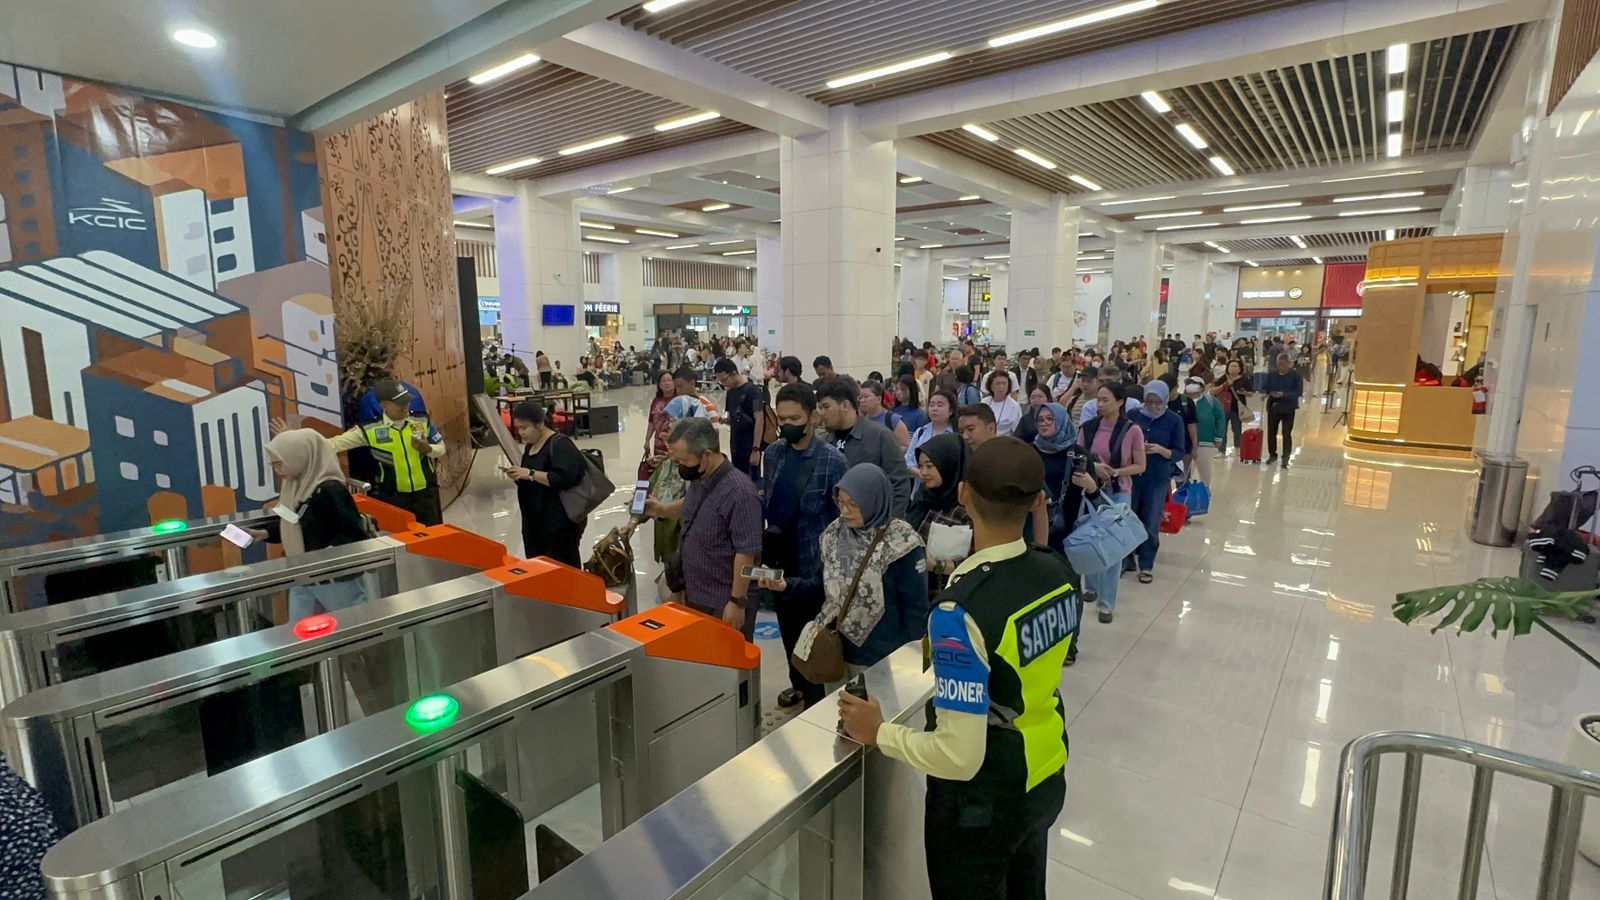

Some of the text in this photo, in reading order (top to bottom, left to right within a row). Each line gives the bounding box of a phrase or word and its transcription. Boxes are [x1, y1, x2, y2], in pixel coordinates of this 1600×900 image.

[68, 212, 146, 230] KCIC
[595, 302, 618, 313] FÉERIE
[1021, 593, 1077, 659] SATPAM
[934, 650, 972, 665] CIC
